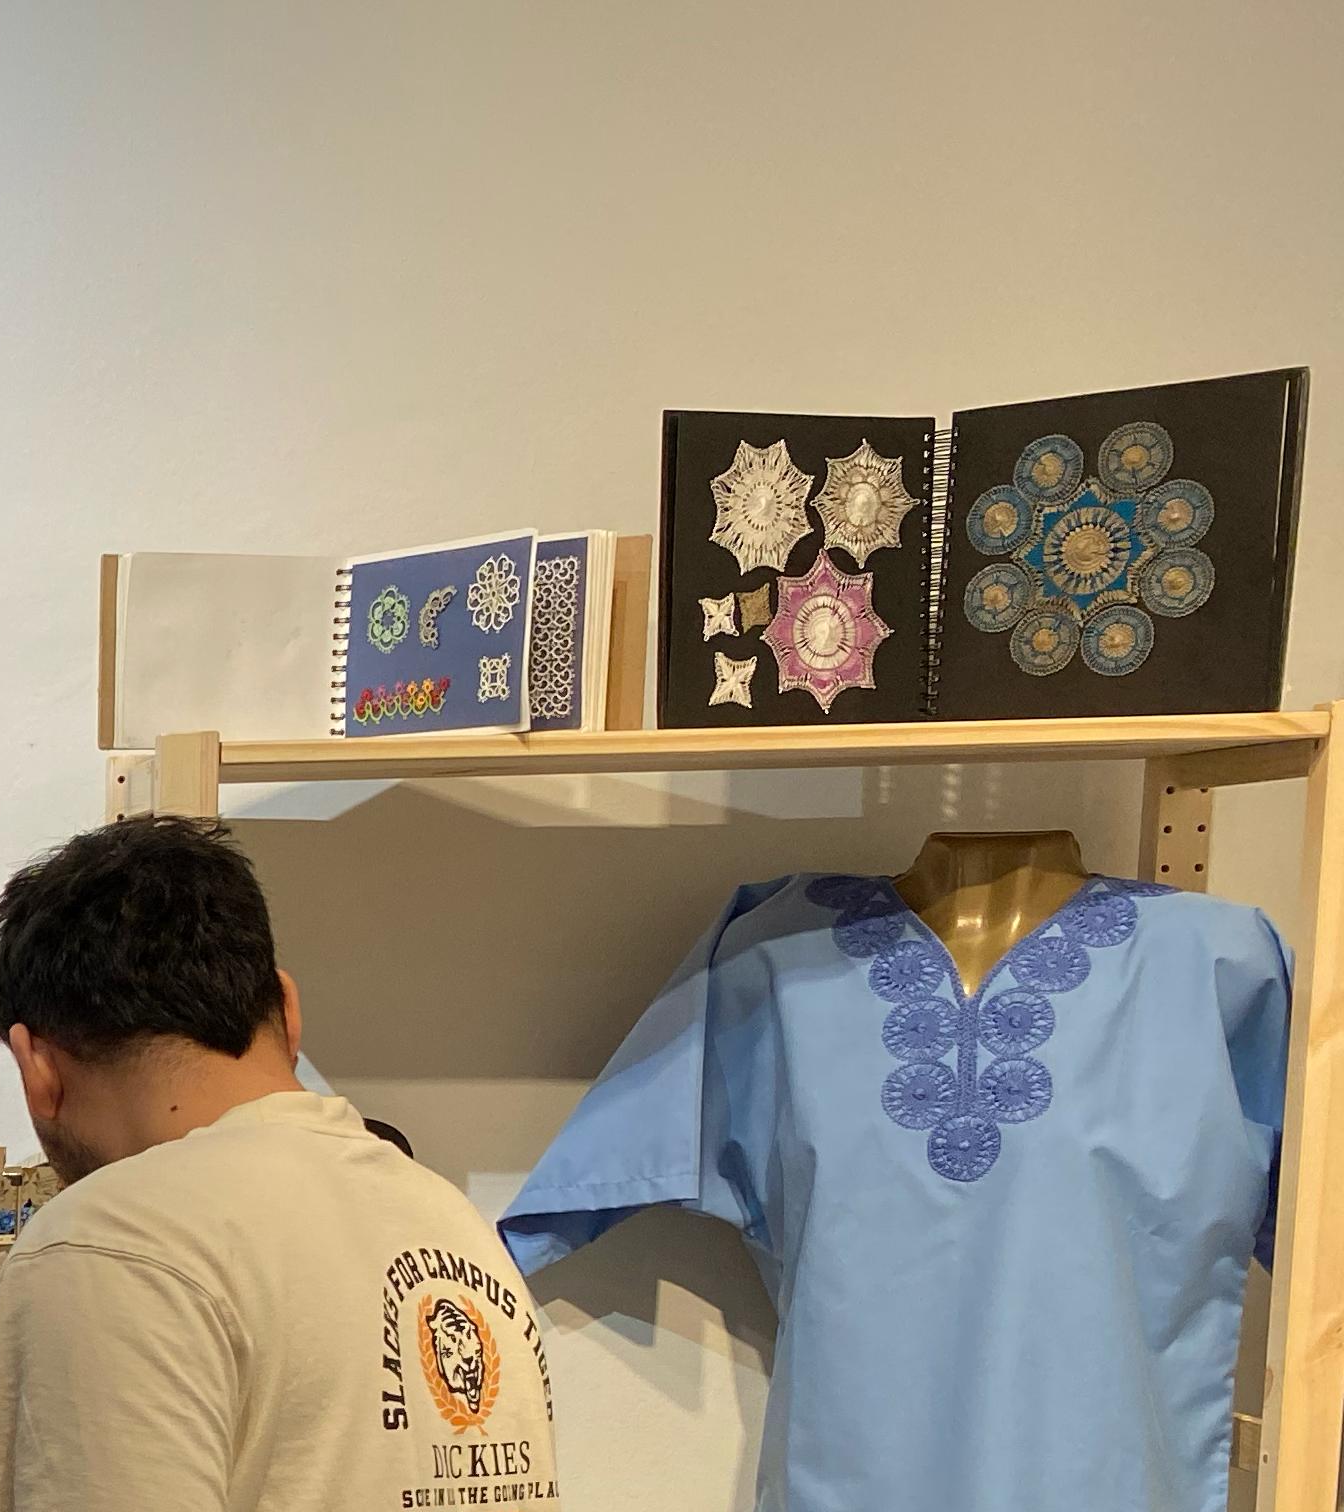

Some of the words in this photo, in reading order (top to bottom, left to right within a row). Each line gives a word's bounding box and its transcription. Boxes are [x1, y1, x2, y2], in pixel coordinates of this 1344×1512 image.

[386, 1250, 424, 1302] FOR
[419, 1248, 517, 1320] CAMPUS
[382, 1287, 409, 1430] SLACKS
[432, 1440, 531, 1479] DICKIES
[458, 1486, 488, 1505] THE
[494, 1483, 525, 1504] GOING
